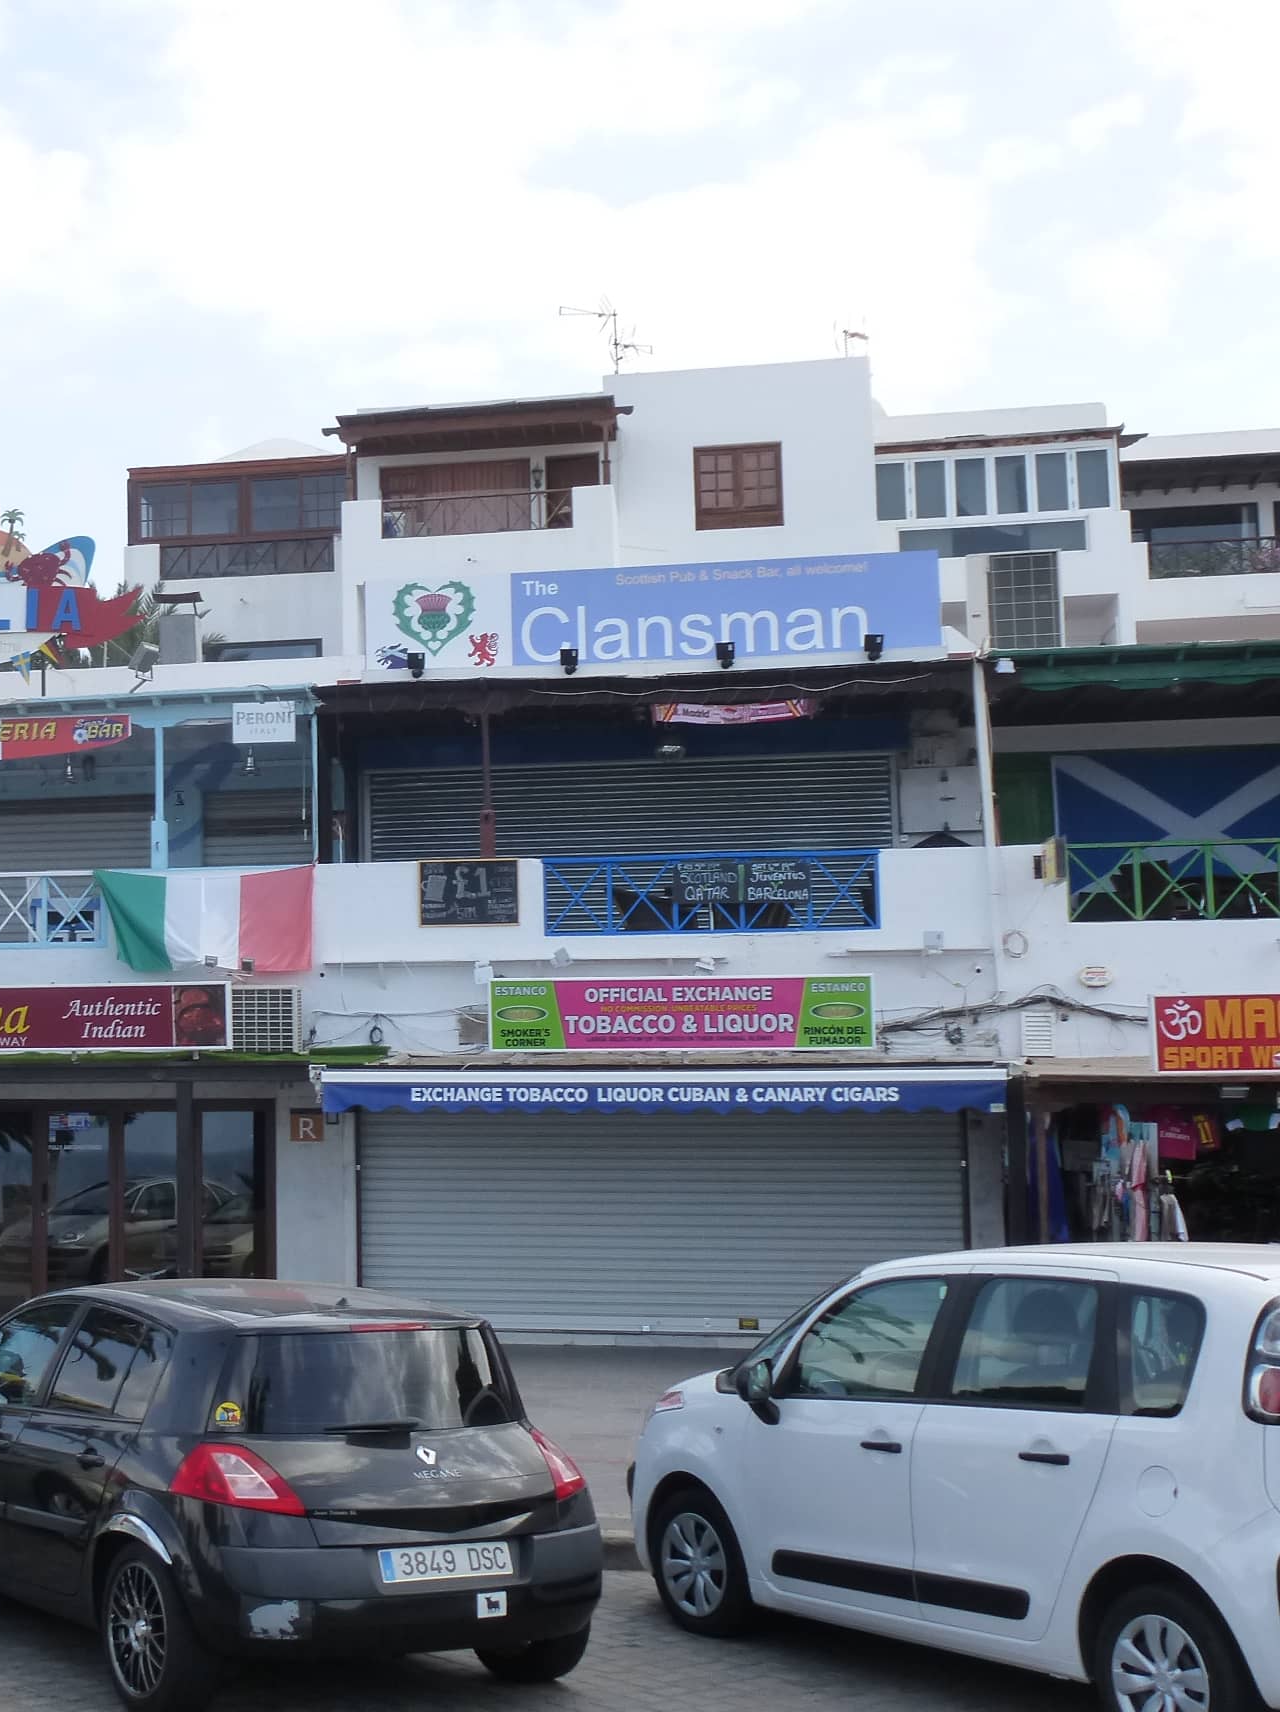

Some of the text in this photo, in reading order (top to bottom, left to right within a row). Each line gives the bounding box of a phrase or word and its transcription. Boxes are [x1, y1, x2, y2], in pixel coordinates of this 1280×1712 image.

[615, 573, 667, 586] Scottish
[670, 570, 696, 582] Pub
[698, 570, 710, 582] &
[712, 567, 753, 581] Snack
[786, 563, 802, 577] all
[806, 560, 868, 575] welcome!
[521, 580, 559, 596] The
[521, 604, 870, 663] Clansman
[236, 711, 292, 725] PERONI
[86, 723, 124, 739] BAR
[679, 872, 738, 884] SCOTLAND
[749, 871, 807, 882] JUVENTUS
[684, 886, 730, 900] QATAR
[747, 886, 809, 901] BARCELONA
[495, 986, 547, 996] ESTANCO
[584, 986, 773, 1003] OFFICIAL EXCHANGE
[811, 982, 866, 993] ESTANCO
[61, 996, 162, 1019] Authentic
[564, 1013, 795, 1034] TOBACCO & LIQUOR
[1204, 998, 1280, 1040] MA
[81, 1019, 147, 1039] Indian
[500, 1028, 551, 1037] SMOKER'S
[804, 1024, 867, 1035] RINCÓN DEL
[505, 1038, 546, 1047] CORNER
[808, 1036, 861, 1045] FUMADOR
[1163, 1045, 1243, 1070] SPORT
[410, 1087, 900, 1102] EXCHANGE TOBACCO LIQUOR CUBAN & CANARY CIGARS
[299, 1117, 317, 1139] R
[399, 1545, 507, 1577] 3849 DSC
